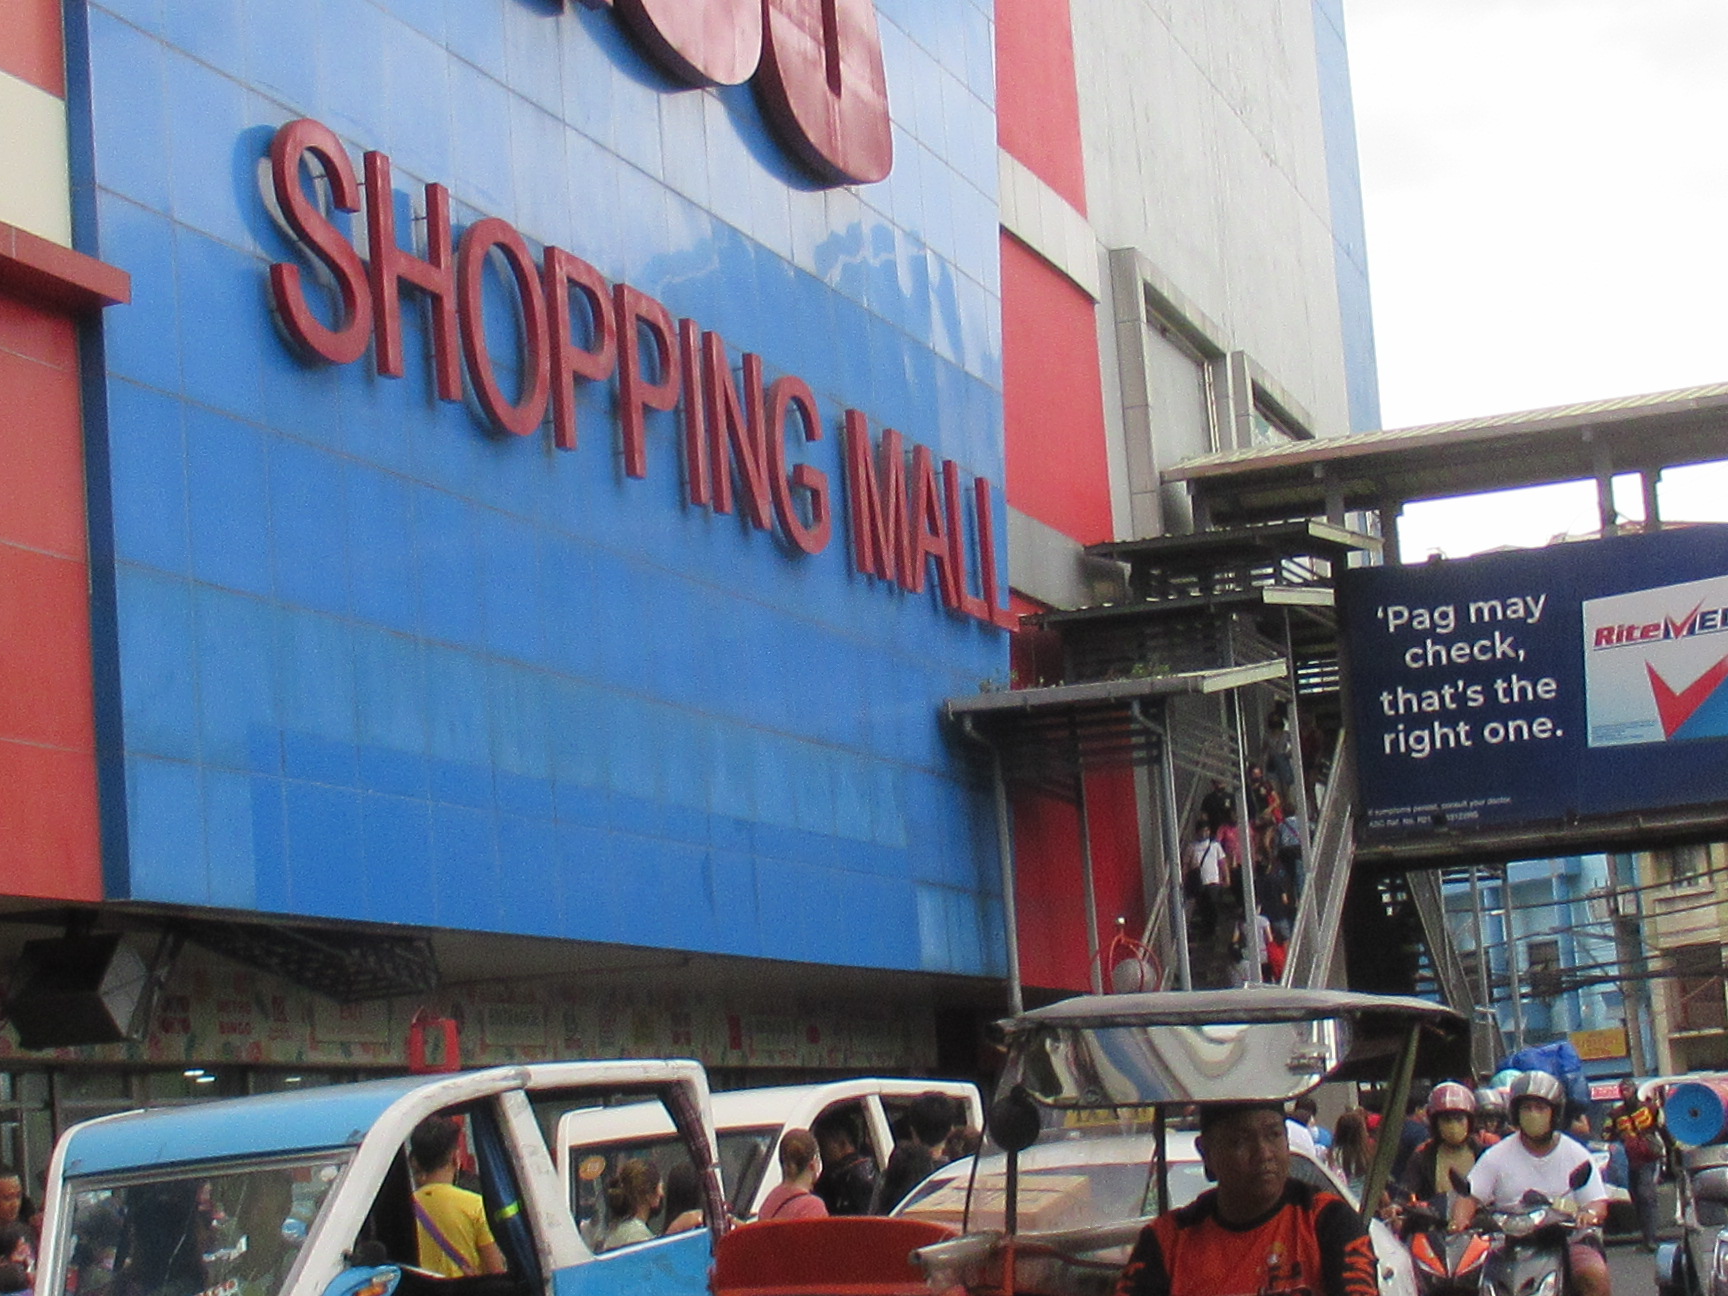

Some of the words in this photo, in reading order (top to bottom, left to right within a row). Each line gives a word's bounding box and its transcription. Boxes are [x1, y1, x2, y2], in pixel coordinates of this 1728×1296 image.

[272, 119, 830, 555] SHOPPING
[845, 408, 1019, 631] MALL
[1469, 592, 1548, 625] may
[1404, 630, 1526, 669] check,
[1380, 679, 1485, 716] that’s
[1494, 673, 1558, 704] the
[1383, 720, 1473, 758] right
[1483, 716, 1565, 745] one.
